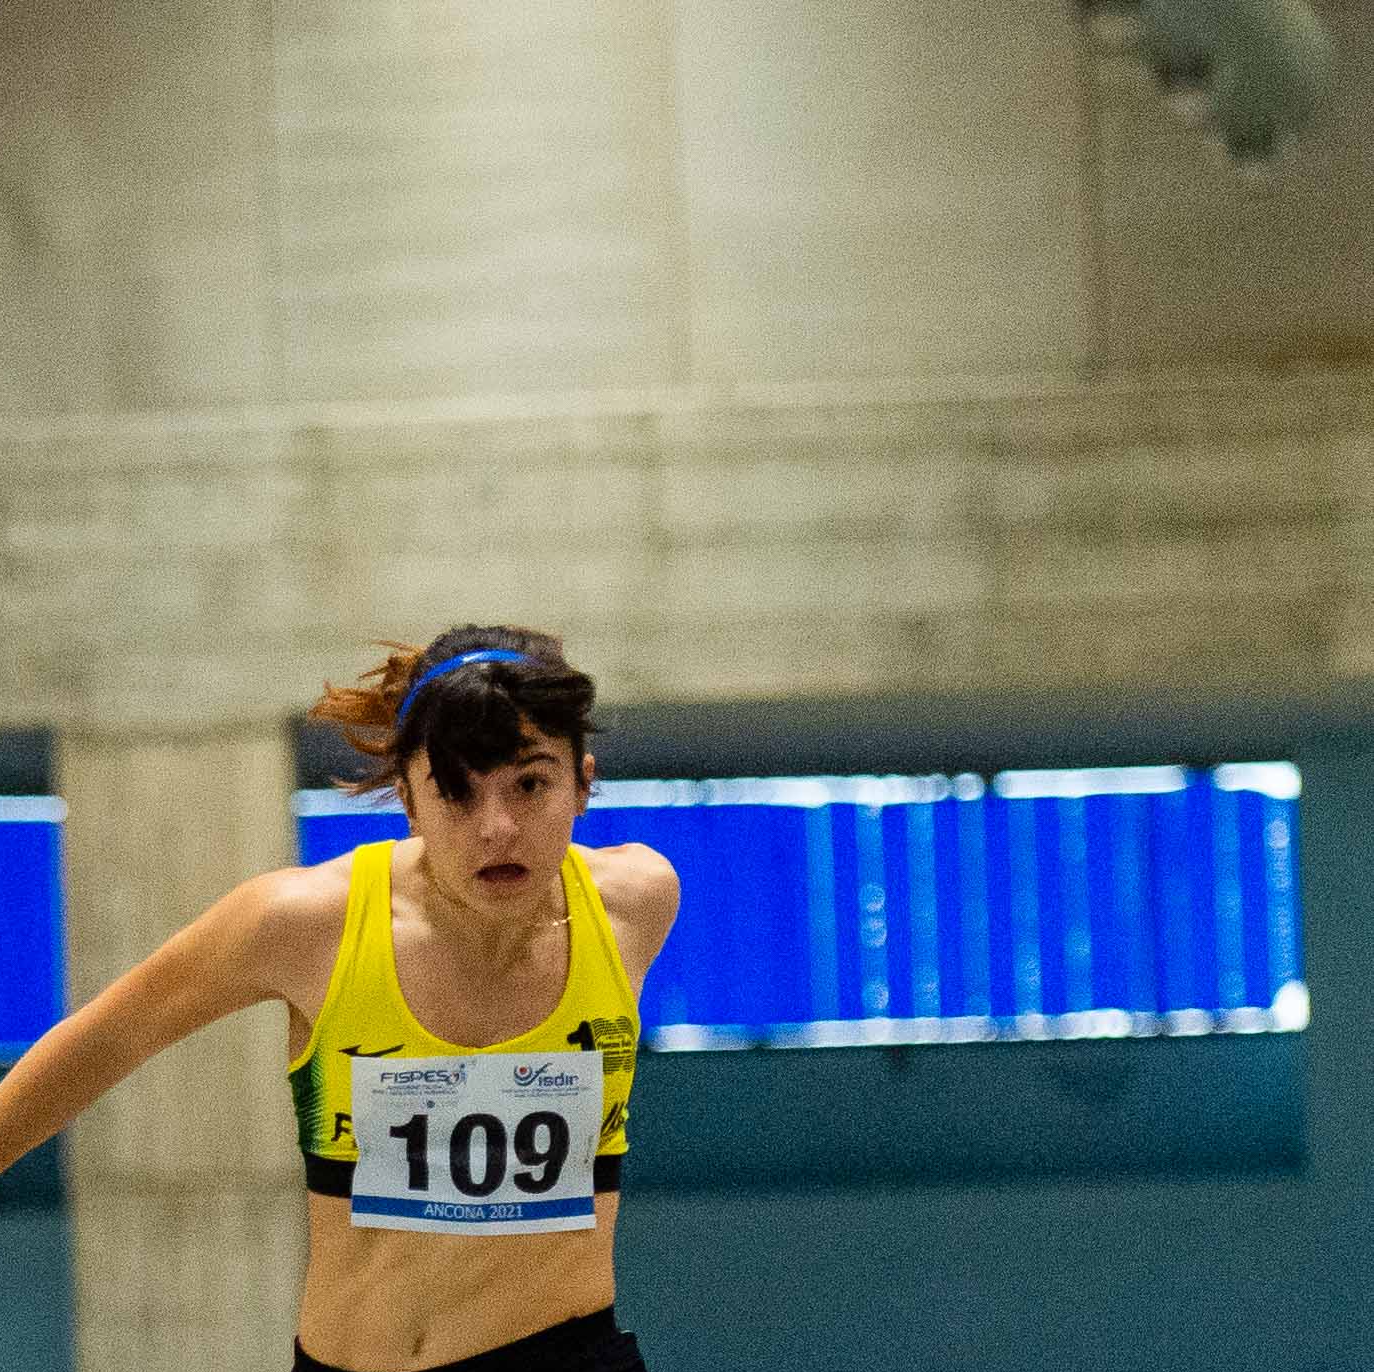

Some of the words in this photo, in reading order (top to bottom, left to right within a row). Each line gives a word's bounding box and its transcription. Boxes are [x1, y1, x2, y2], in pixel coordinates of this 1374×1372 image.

[379, 1069, 449, 1084] FISPES
[389, 1110, 570, 1197] 109
[424, 1202, 486, 1219] ANCONA
[490, 1203, 524, 1219] 2021
